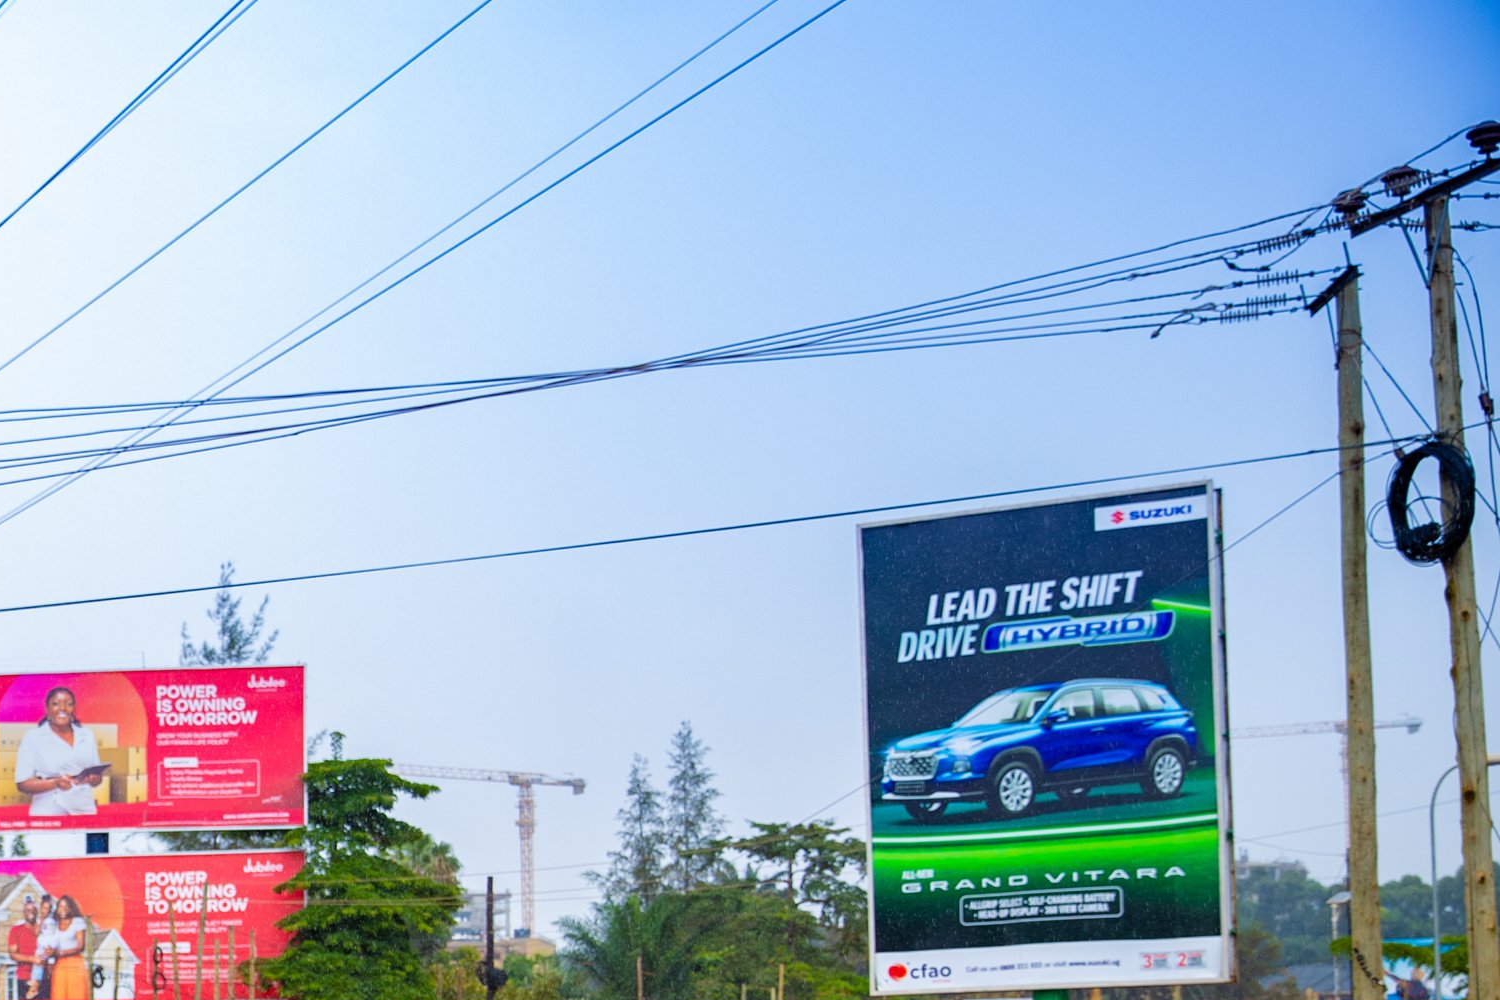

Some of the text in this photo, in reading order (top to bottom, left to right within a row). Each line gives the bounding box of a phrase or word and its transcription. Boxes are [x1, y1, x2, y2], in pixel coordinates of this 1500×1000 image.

[1129, 504, 1192, 521] SUZUKI
[926, 569, 1144, 626] LEAD THE SHIFT
[897, 616, 1146, 664] DRIVE HYBRID
[246, 673, 287, 689] Jubilee
[155, 683, 218, 700] POWER
[155, 697, 246, 713] IS OWNING
[155, 710, 258, 727] TOMORROW
[243, 858, 284, 873] Jubilee
[144, 870, 208, 887] POWER
[901, 866, 1186, 894] GRAND VITARA
[144, 883, 237, 900] IS OWNING
[999, 897, 1024, 908] SELECT
[1084, 891, 1117, 903] BATTERY
[1010, 906, 1040, 918] DISPLAY
[1059, 903, 1077, 914] VIEW
[1078, 902, 1110, 913] CAMERA
[1142, 953, 1153, 969] 3
[1177, 951, 1187, 968] 2
[910, 963, 952, 979] cfao
